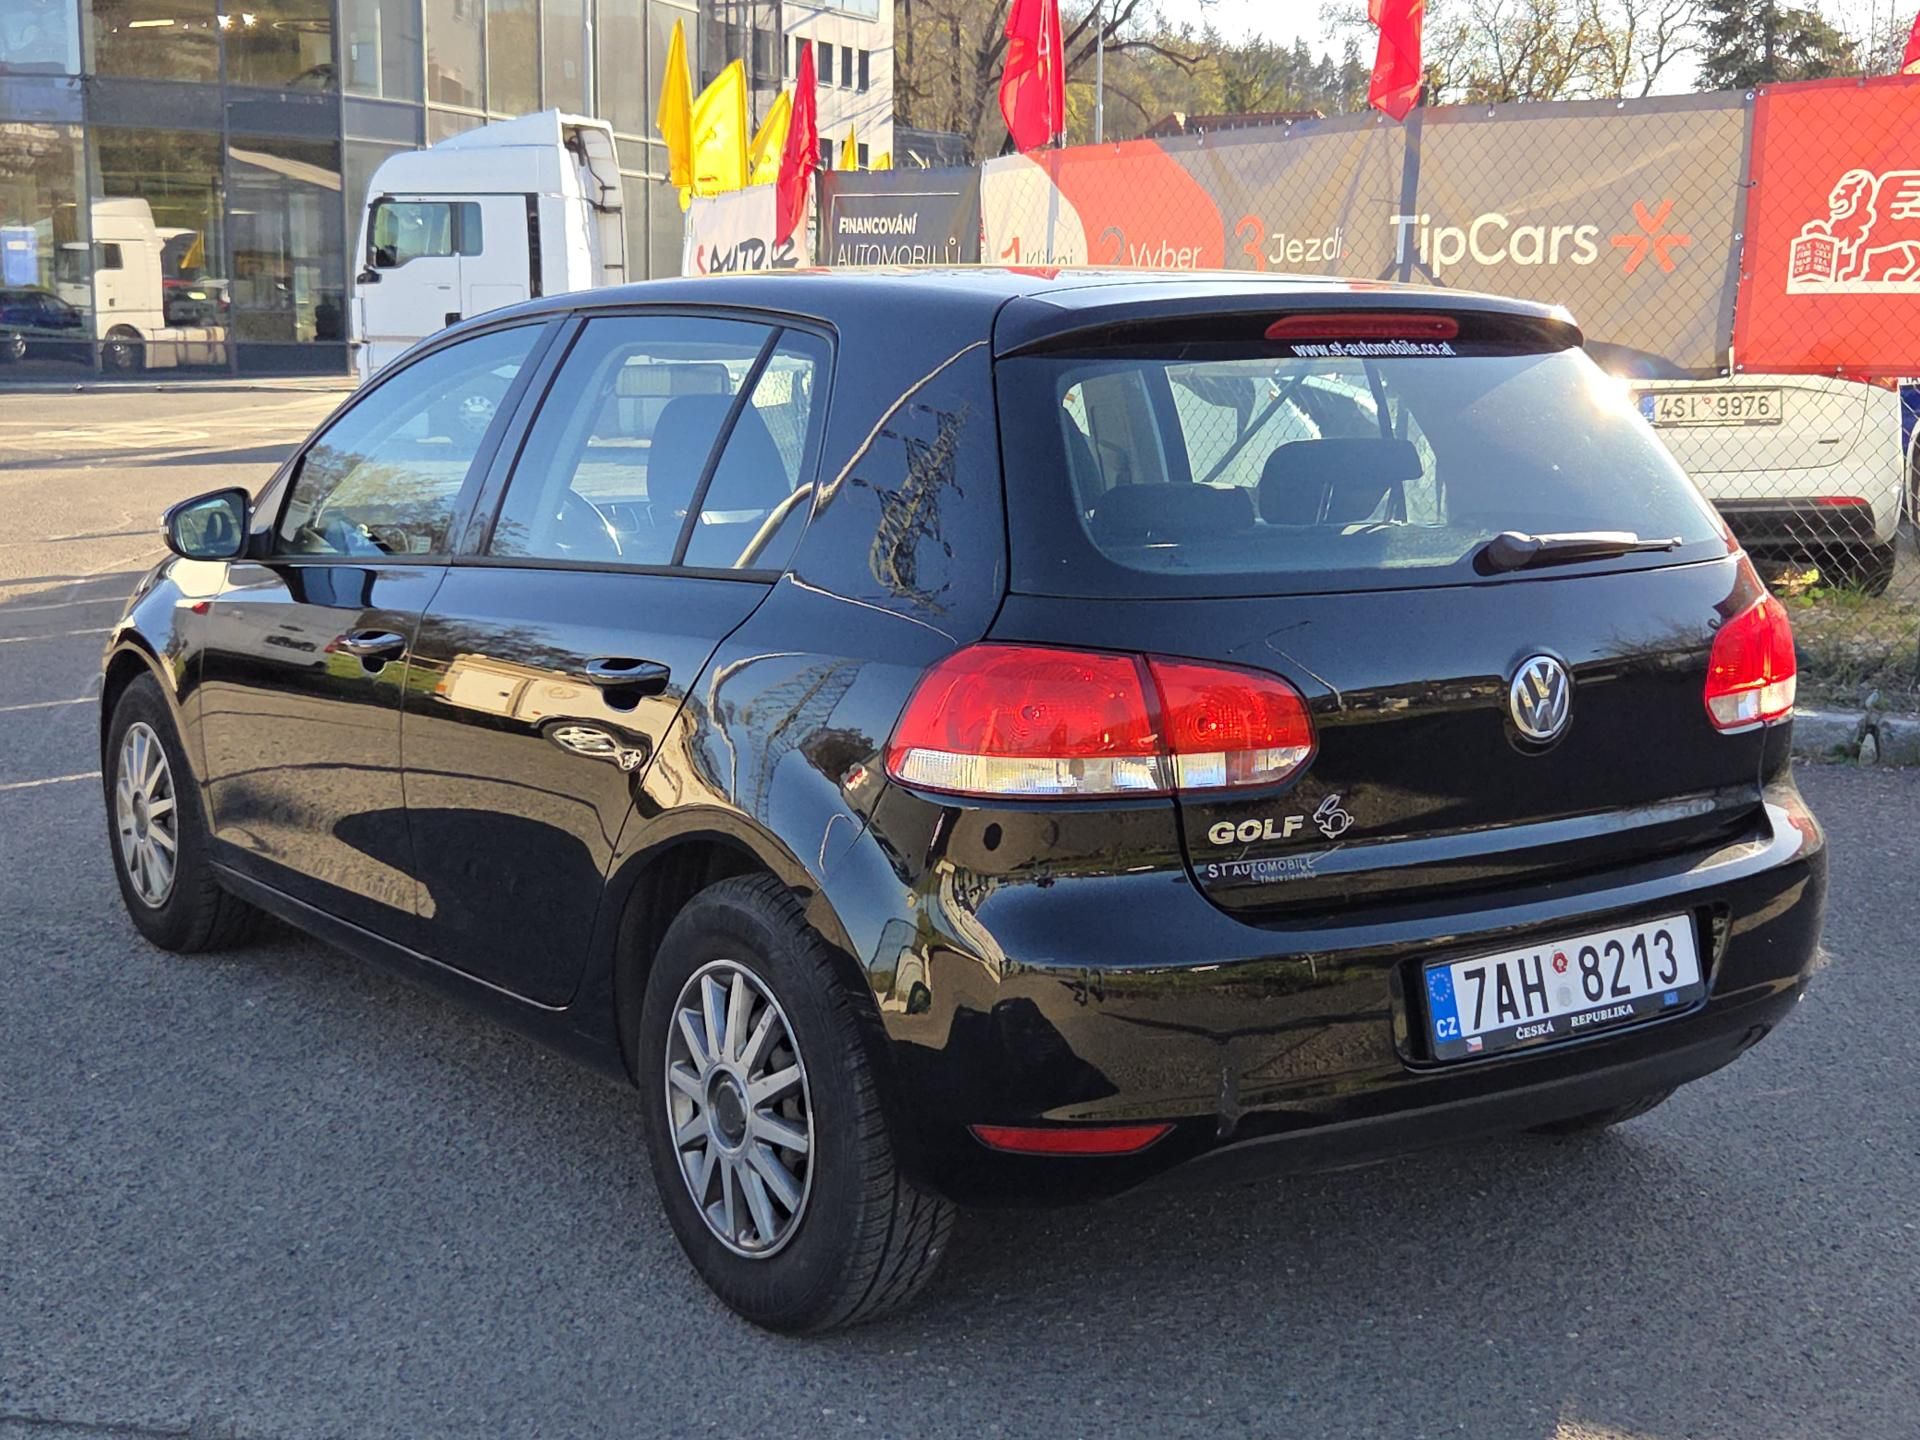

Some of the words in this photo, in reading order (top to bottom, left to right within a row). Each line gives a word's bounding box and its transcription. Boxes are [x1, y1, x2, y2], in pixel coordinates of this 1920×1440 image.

[838, 213, 918, 235] FINANCOVÁNÍ
[1001, 236, 1020, 264] 1
[1236, 215, 1265, 272] 3
[1390, 212, 1600, 278] TipCars
[1290, 340, 1457, 357] www.st-automobile.co.at
[1717, 395, 1770, 417] 9976
[1208, 815, 1304, 845] GOLF
[1464, 955, 1550, 1030] 7AH
[1578, 929, 1678, 1003] 8213
[1436, 1016, 1458, 1038] CZ
[1516, 1020, 1555, 1040] ČESKÁ
[1571, 1004, 1634, 1028] REPUBLIKA
